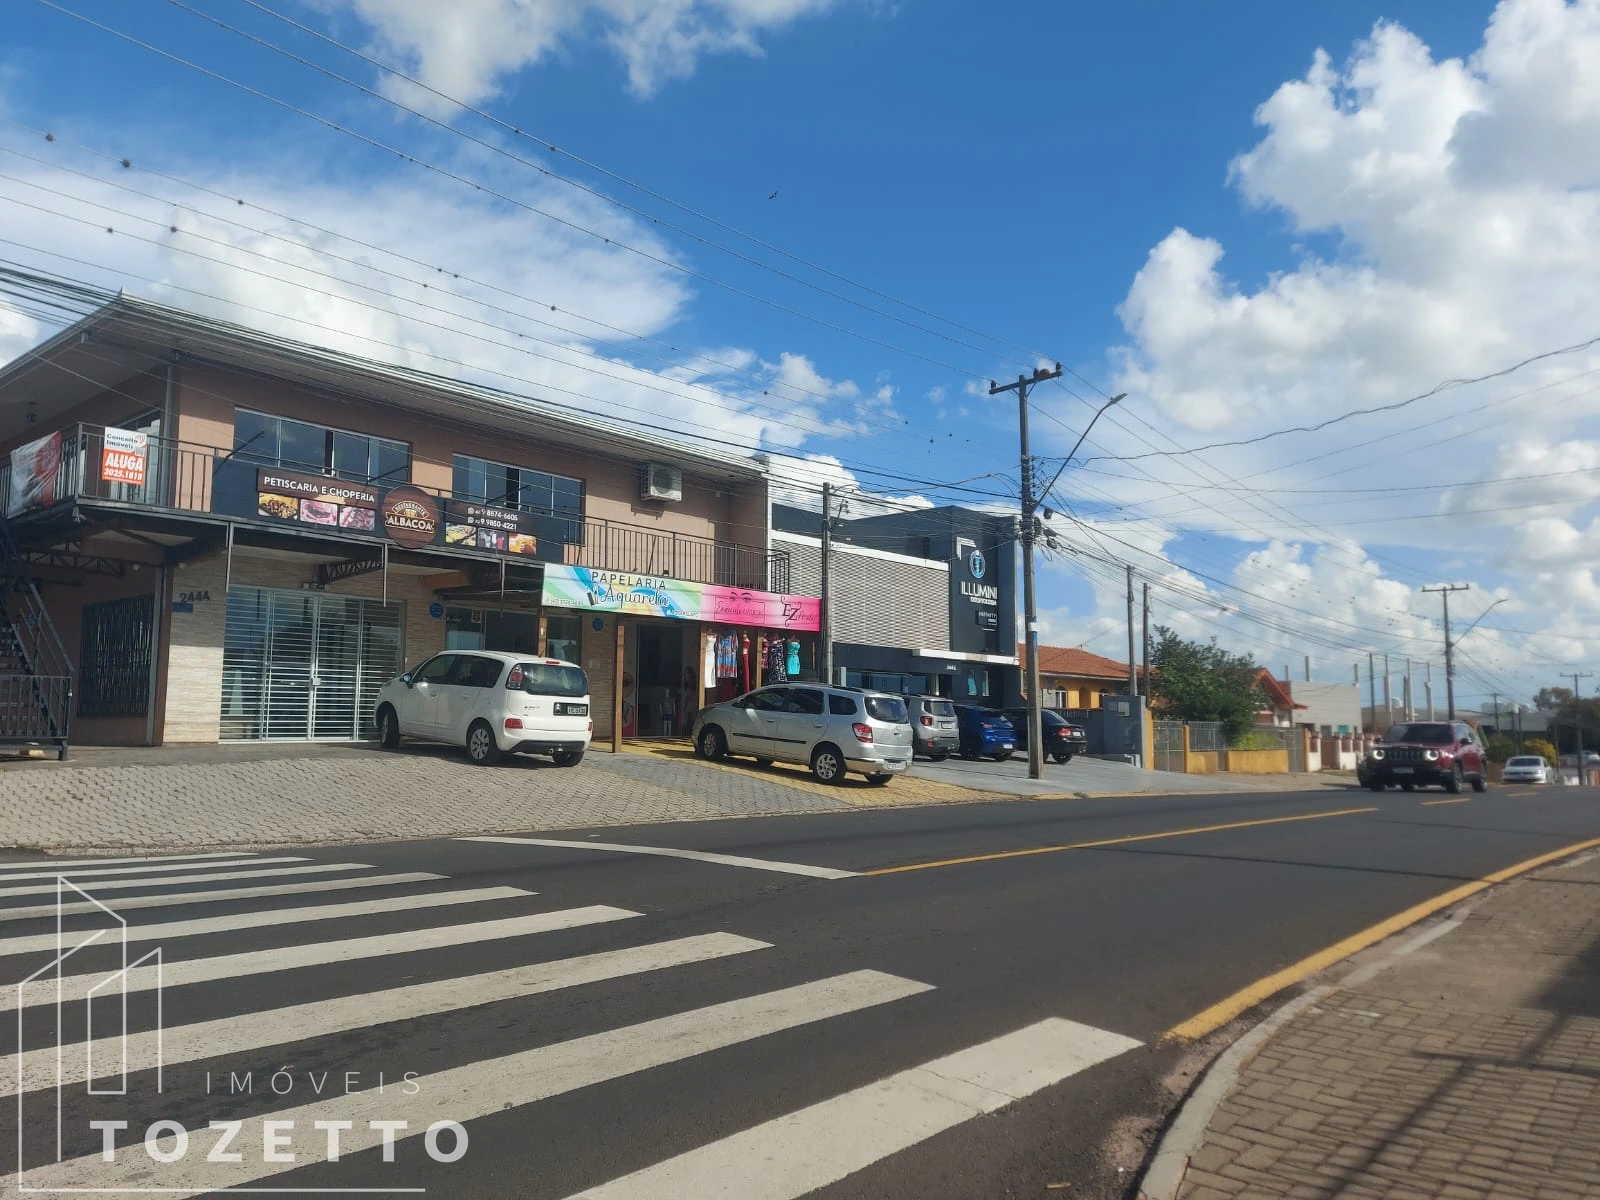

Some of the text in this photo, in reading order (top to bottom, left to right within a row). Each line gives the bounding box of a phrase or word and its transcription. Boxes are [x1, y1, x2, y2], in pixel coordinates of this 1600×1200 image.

[105, 452, 143, 472] ALUGA
[264, 476, 375, 503] PETISCARIA E CHOPERIA
[591, 571, 667, 590] PAPELARIA
[961, 581, 998, 600] ILLUMINI
[600, 584, 670, 609] Aquarela
